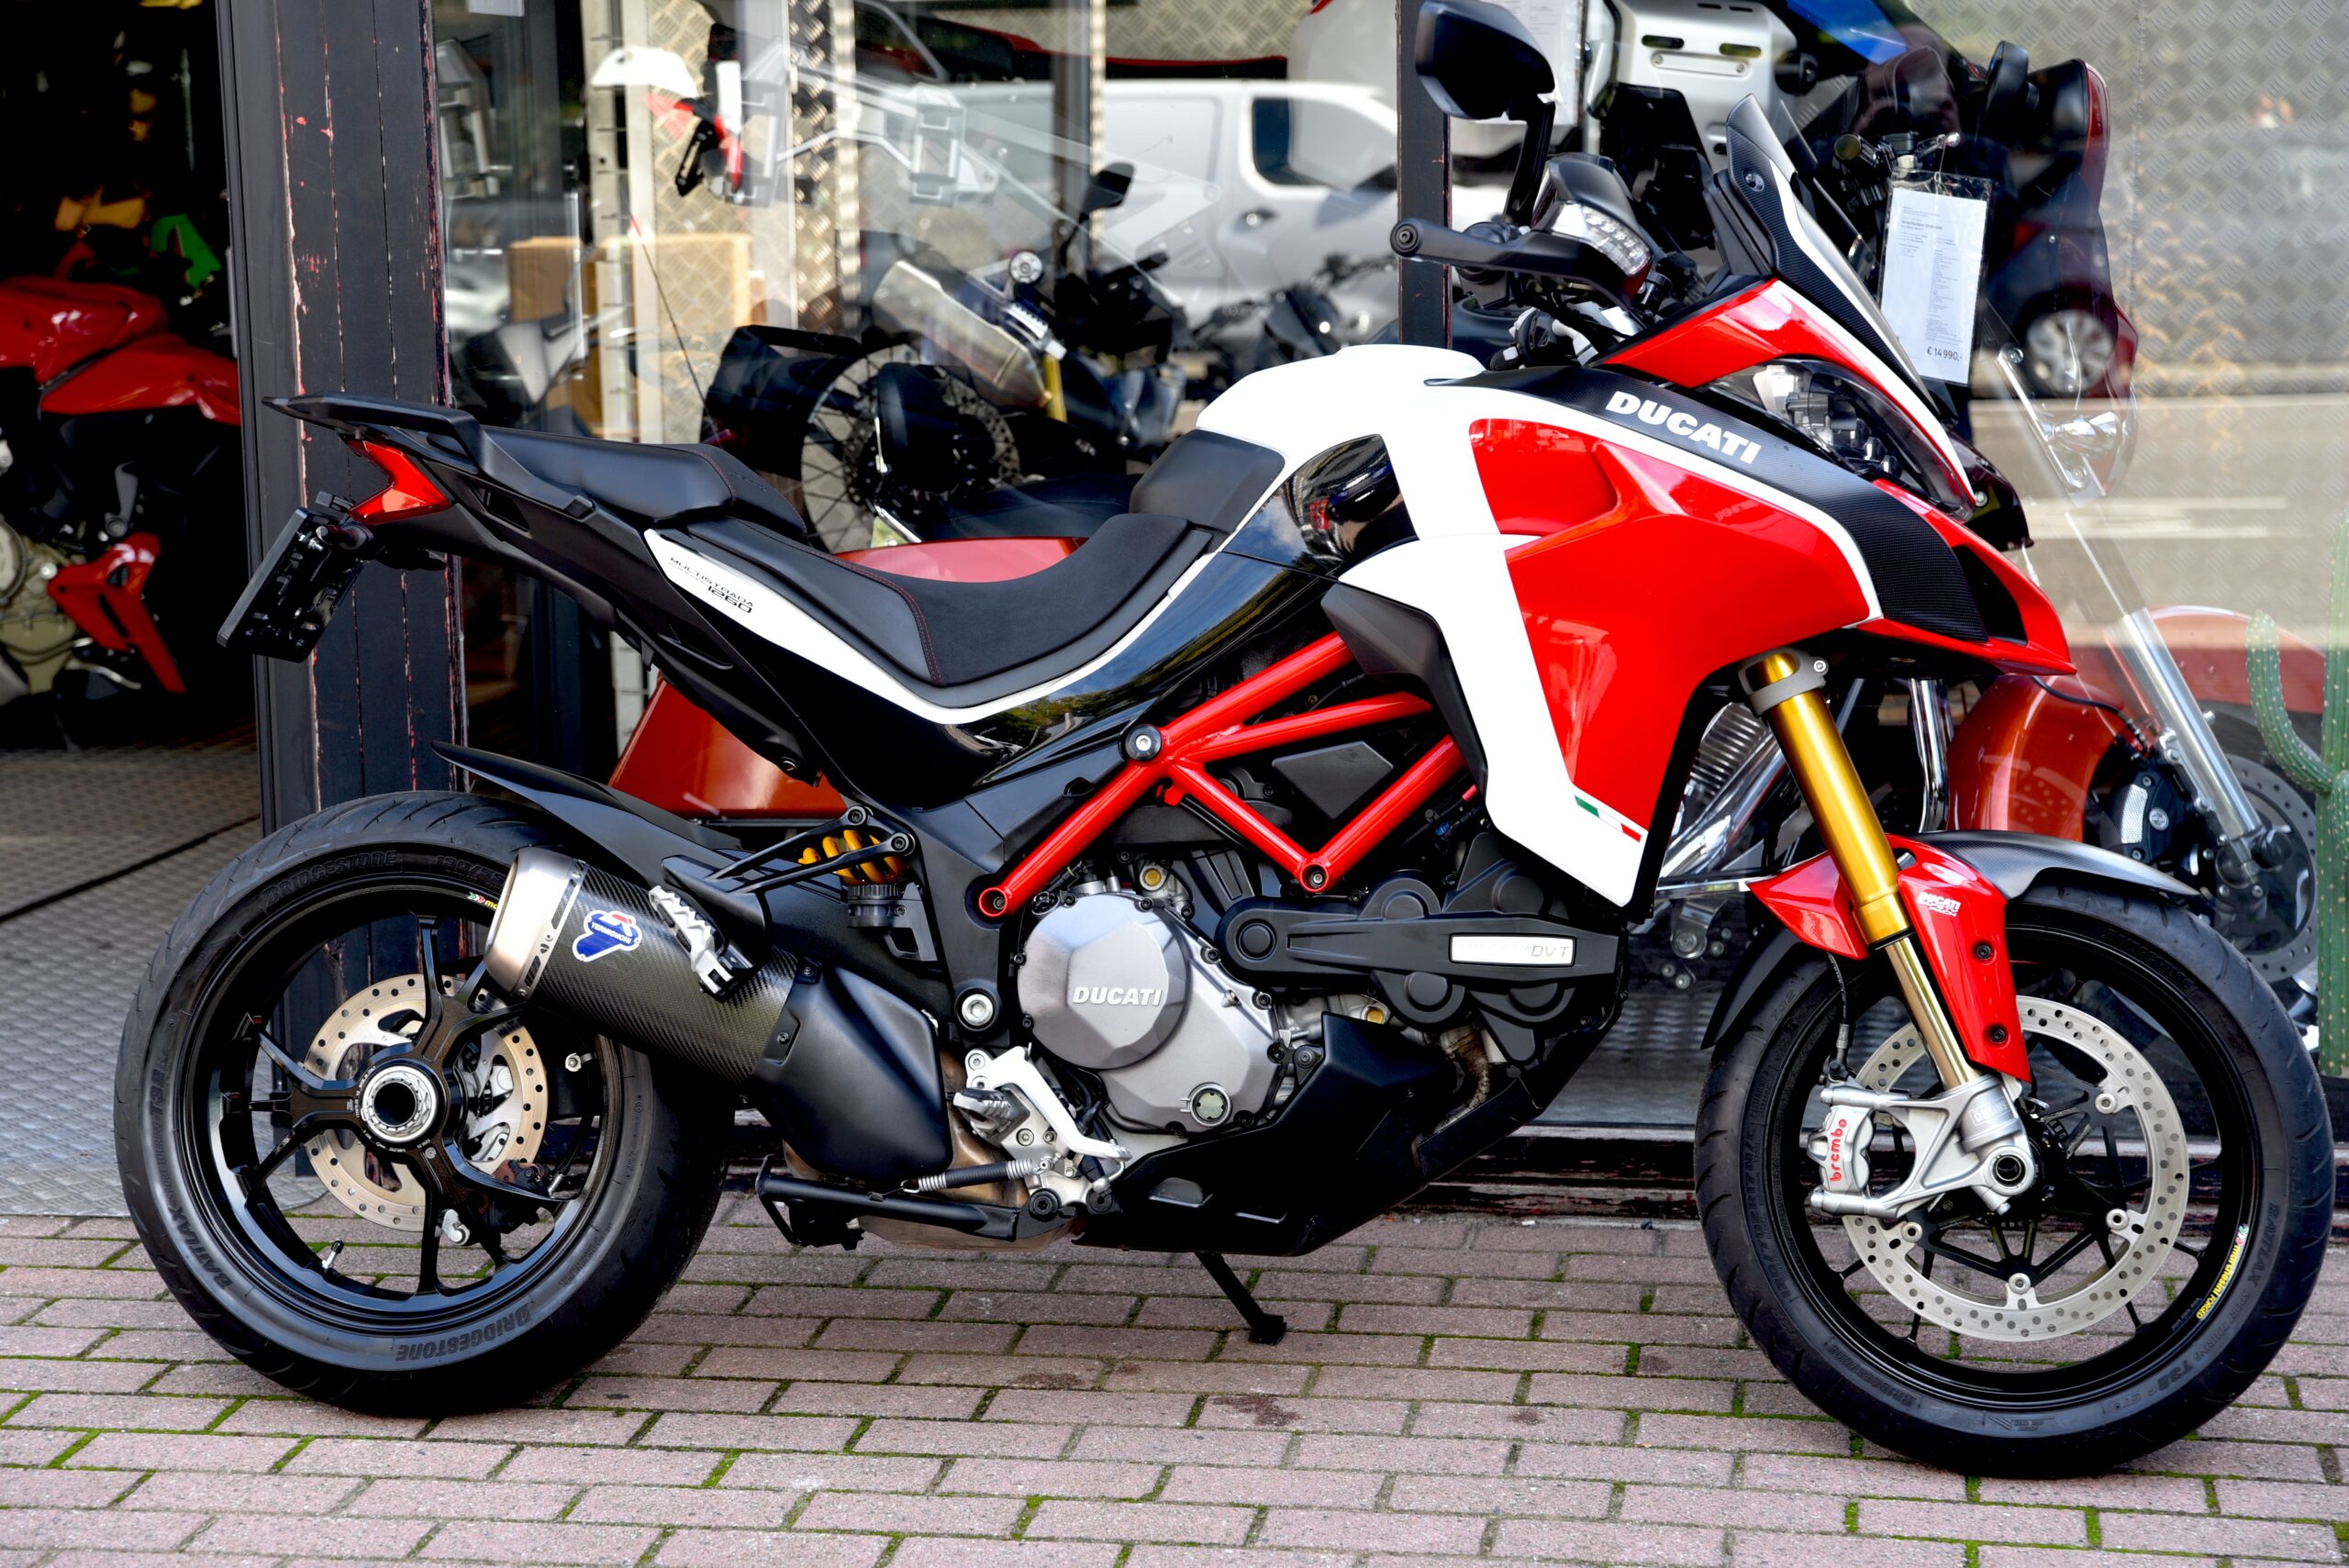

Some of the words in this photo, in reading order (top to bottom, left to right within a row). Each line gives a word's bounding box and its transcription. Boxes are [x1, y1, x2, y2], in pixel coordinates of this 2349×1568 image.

[1927, 346, 1932, 356] €
[1605, 390, 1762, 464] DUCATI
[670, 557, 753, 607] MULTISTRADA
[707, 585, 752, 614] 1260
[1916, 891, 1962, 911] DUCATI
[1530, 944, 1571, 958] DVT
[1072, 986, 1163, 1006] DUCATI
[1829, 1118, 1847, 1182] brembo
[167, 1206, 233, 1290] BATTLAX
[2246, 1202, 2281, 1288] BATTLAX
[395, 1302, 531, 1362] BRIDGESTONE
